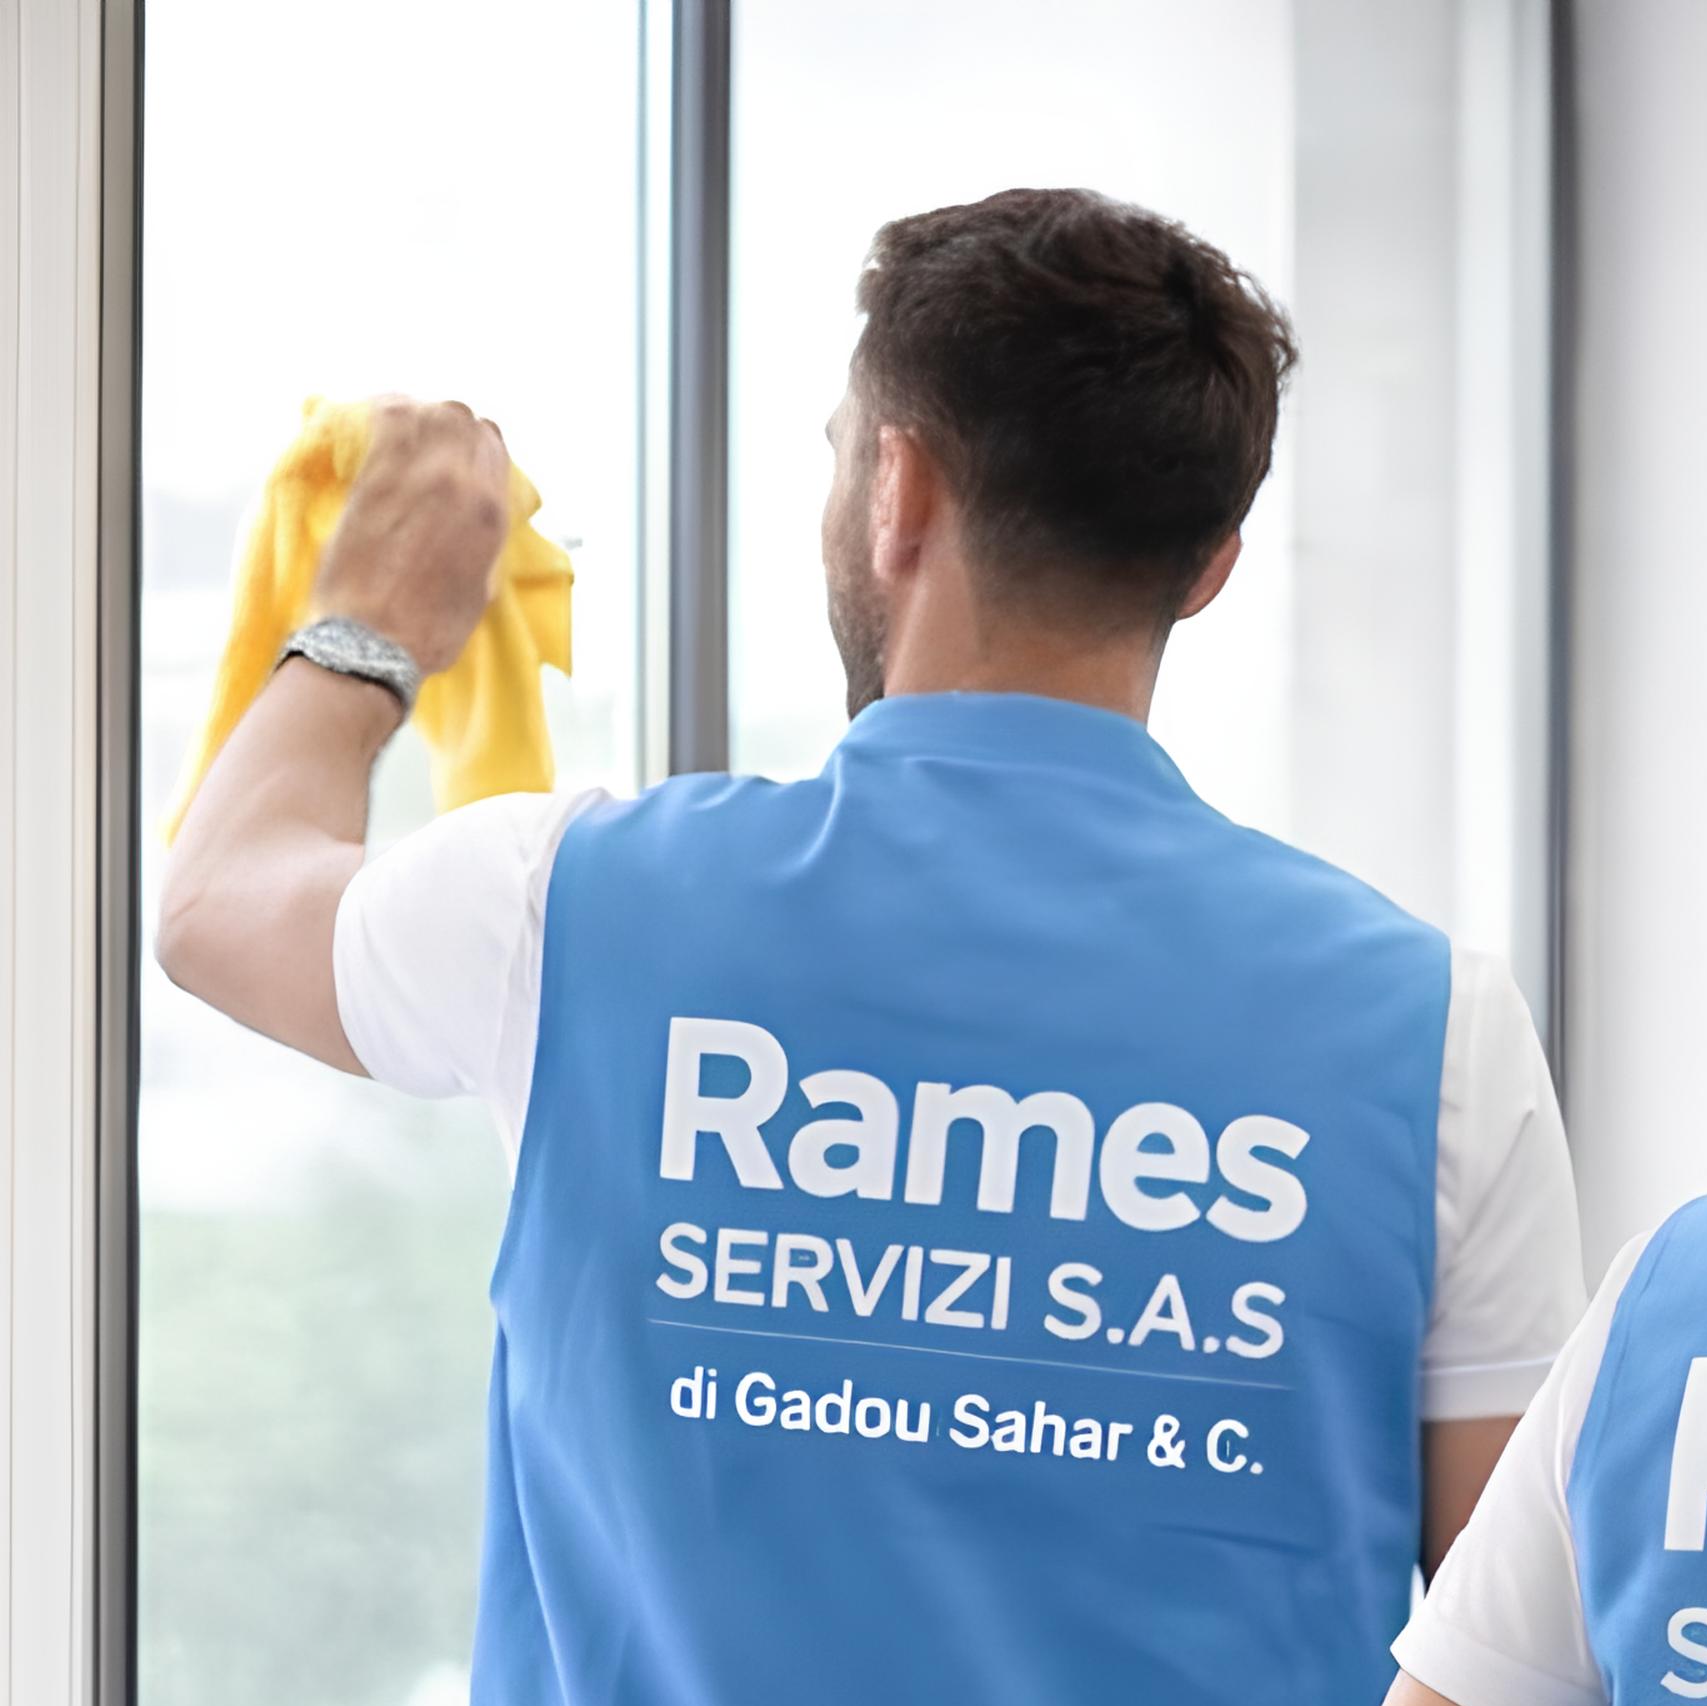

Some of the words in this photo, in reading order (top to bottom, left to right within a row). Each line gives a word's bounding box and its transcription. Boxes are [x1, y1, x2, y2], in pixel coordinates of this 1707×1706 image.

[659, 1017, 1311, 1243] Rames
[655, 1221, 1012, 1331] SERVIZI
[1043, 1262, 1286, 1359] S.A.S
[670, 1366, 718, 1420] di
[735, 1371, 930, 1443] Gadou
[948, 1393, 1133, 1462] Sahar
[1147, 1415, 1186, 1469] &
[1205, 1419, 1264, 1475] C.
